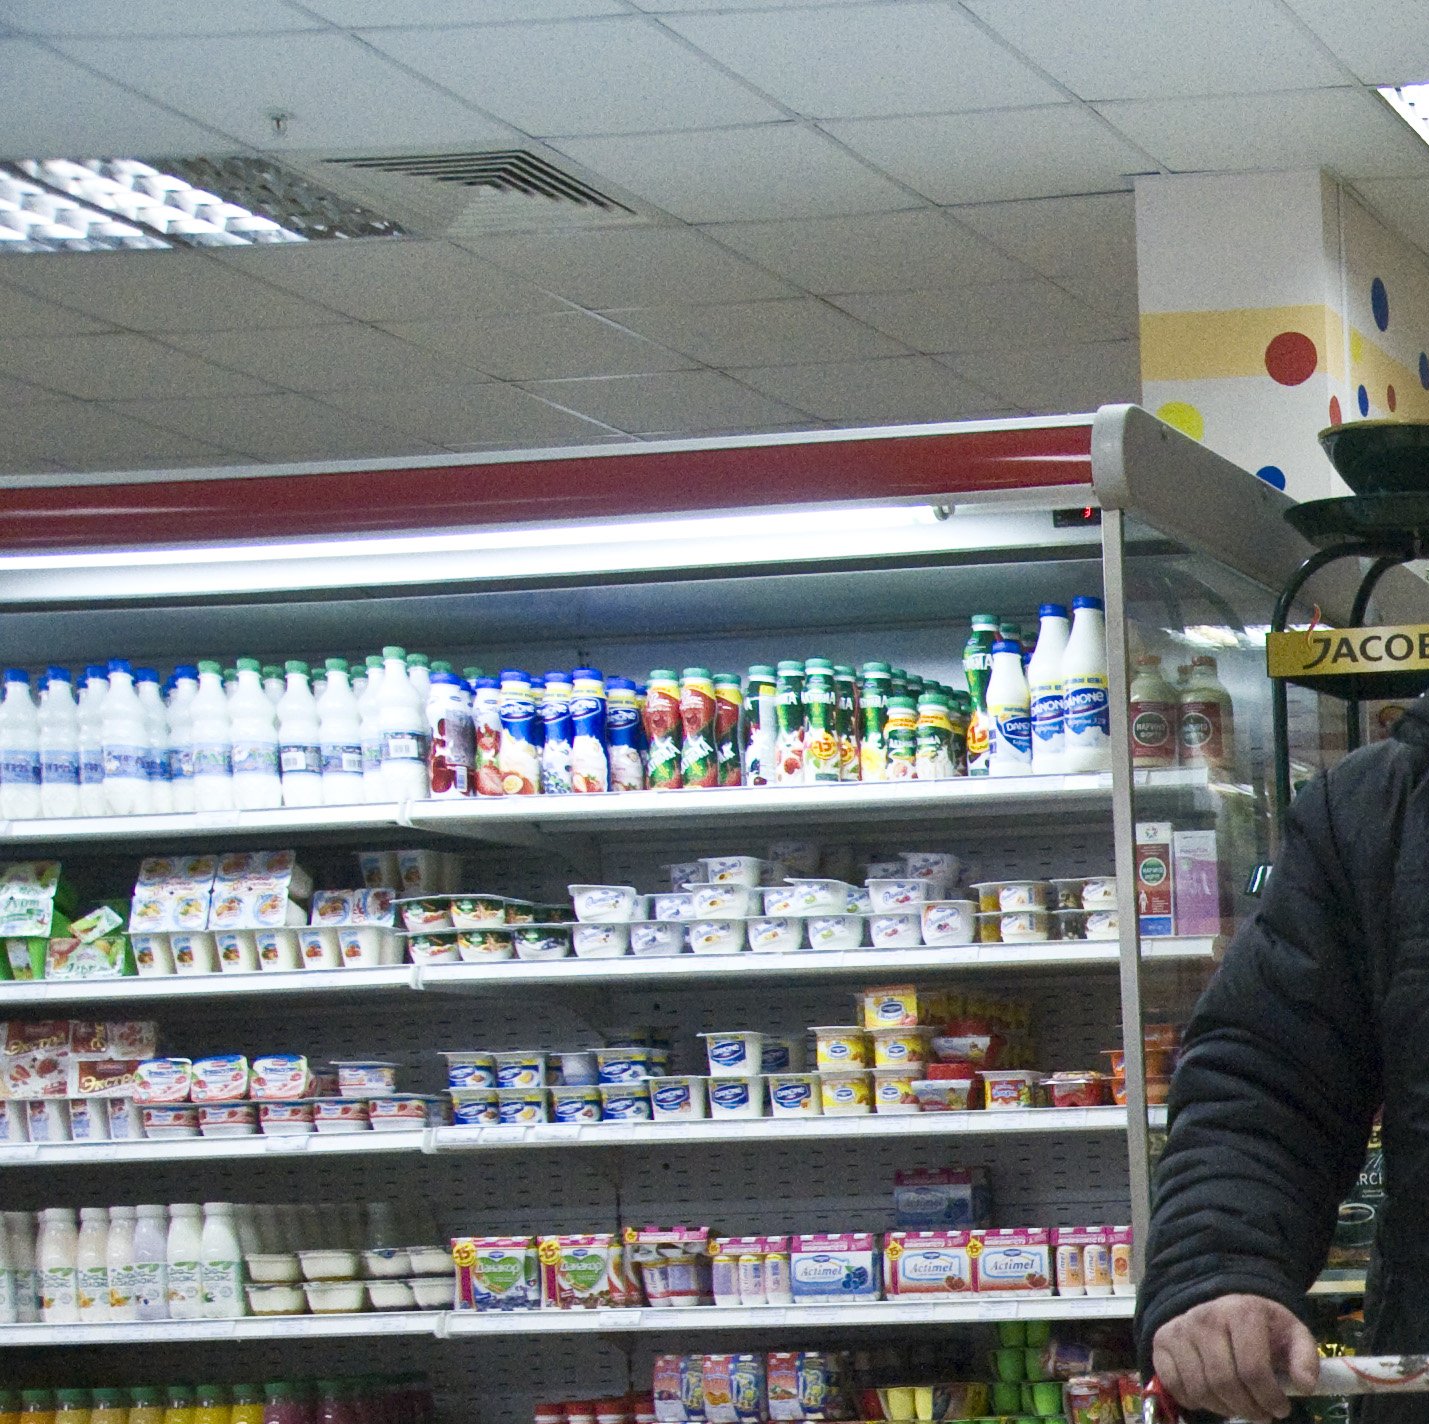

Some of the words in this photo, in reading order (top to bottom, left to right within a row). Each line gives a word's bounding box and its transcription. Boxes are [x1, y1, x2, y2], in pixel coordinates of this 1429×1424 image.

[801, 1264, 842, 1277] Actimel
[910, 1263, 954, 1273] Actimel
[992, 1258, 1035, 1271] Actimel
